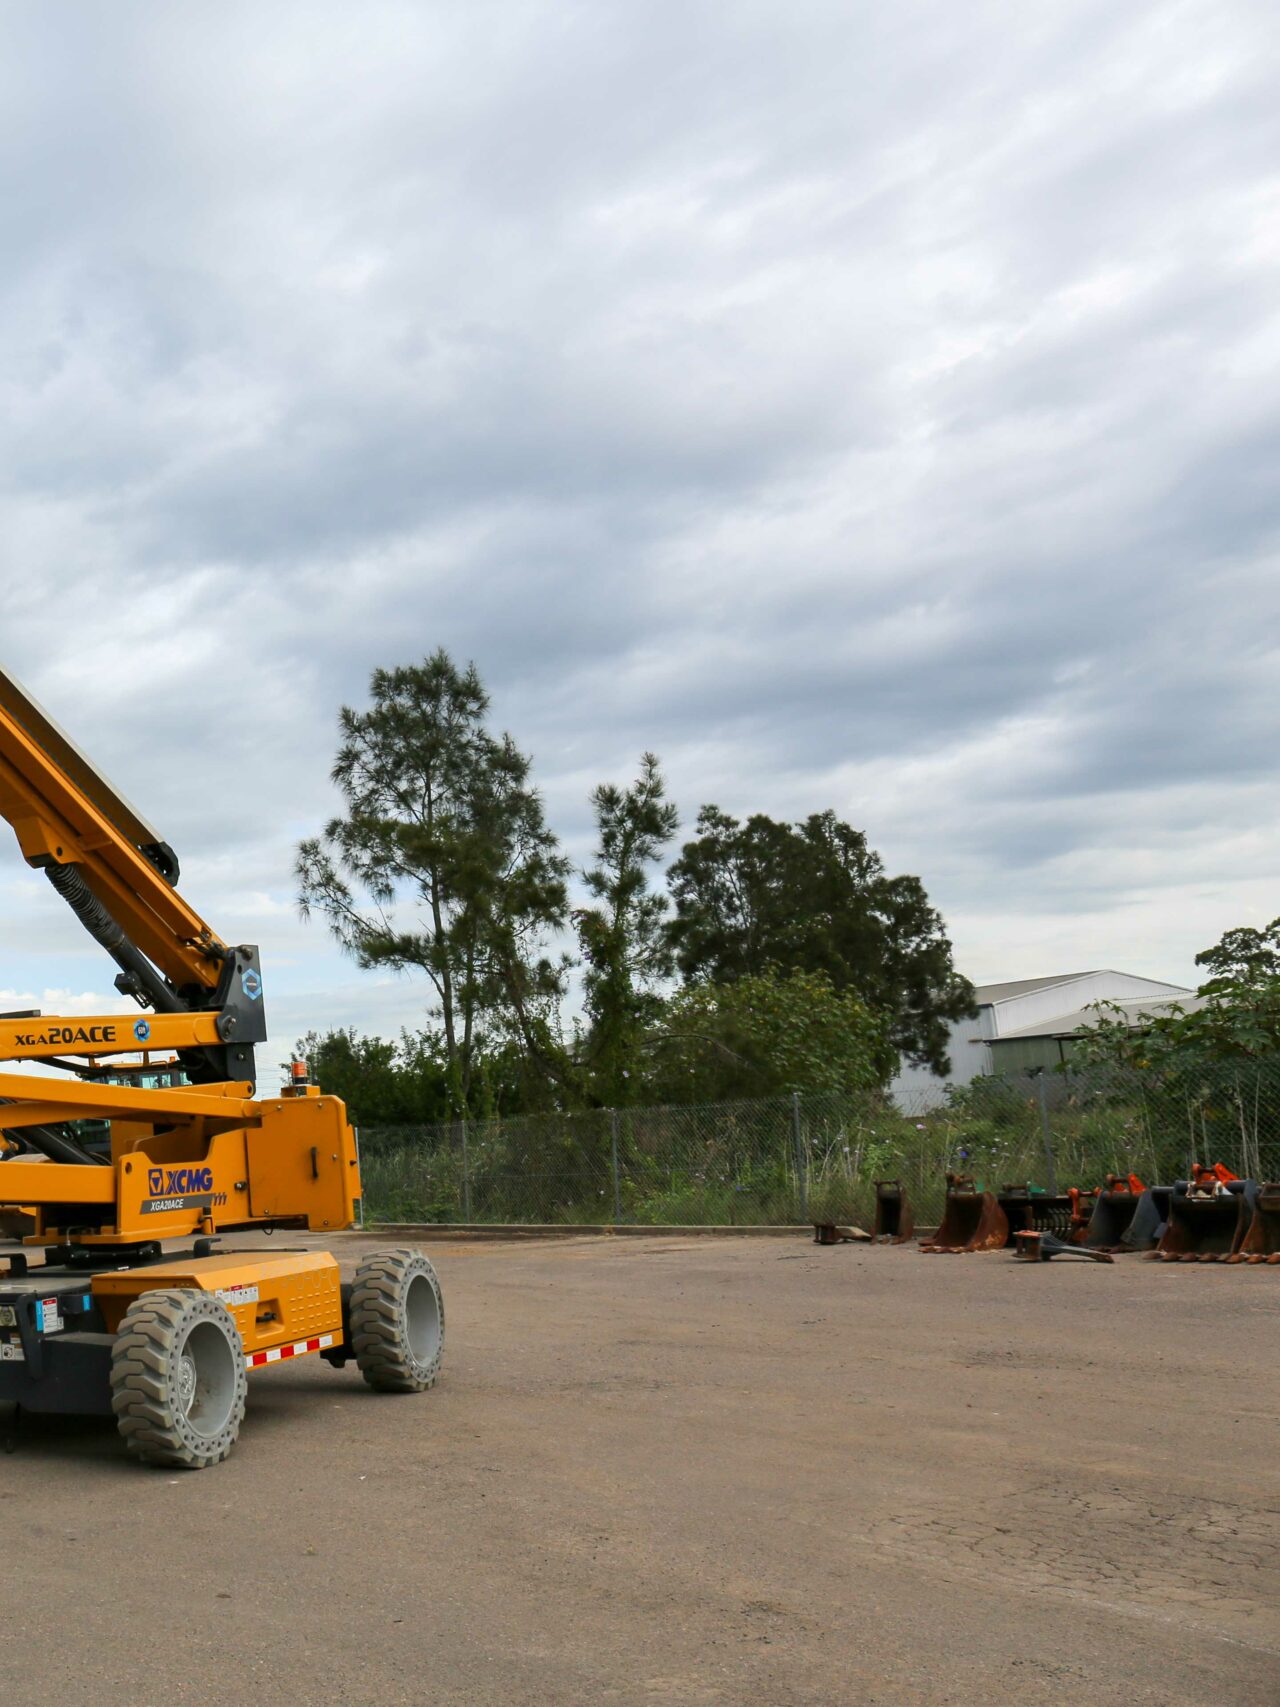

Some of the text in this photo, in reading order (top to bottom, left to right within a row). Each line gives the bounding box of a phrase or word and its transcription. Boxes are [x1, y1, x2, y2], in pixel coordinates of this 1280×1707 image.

[15, 1026, 116, 1046] XGA20ACE
[165, 1167, 213, 1196] XCMG
[150, 1198, 184, 1212] XGA20ACE
